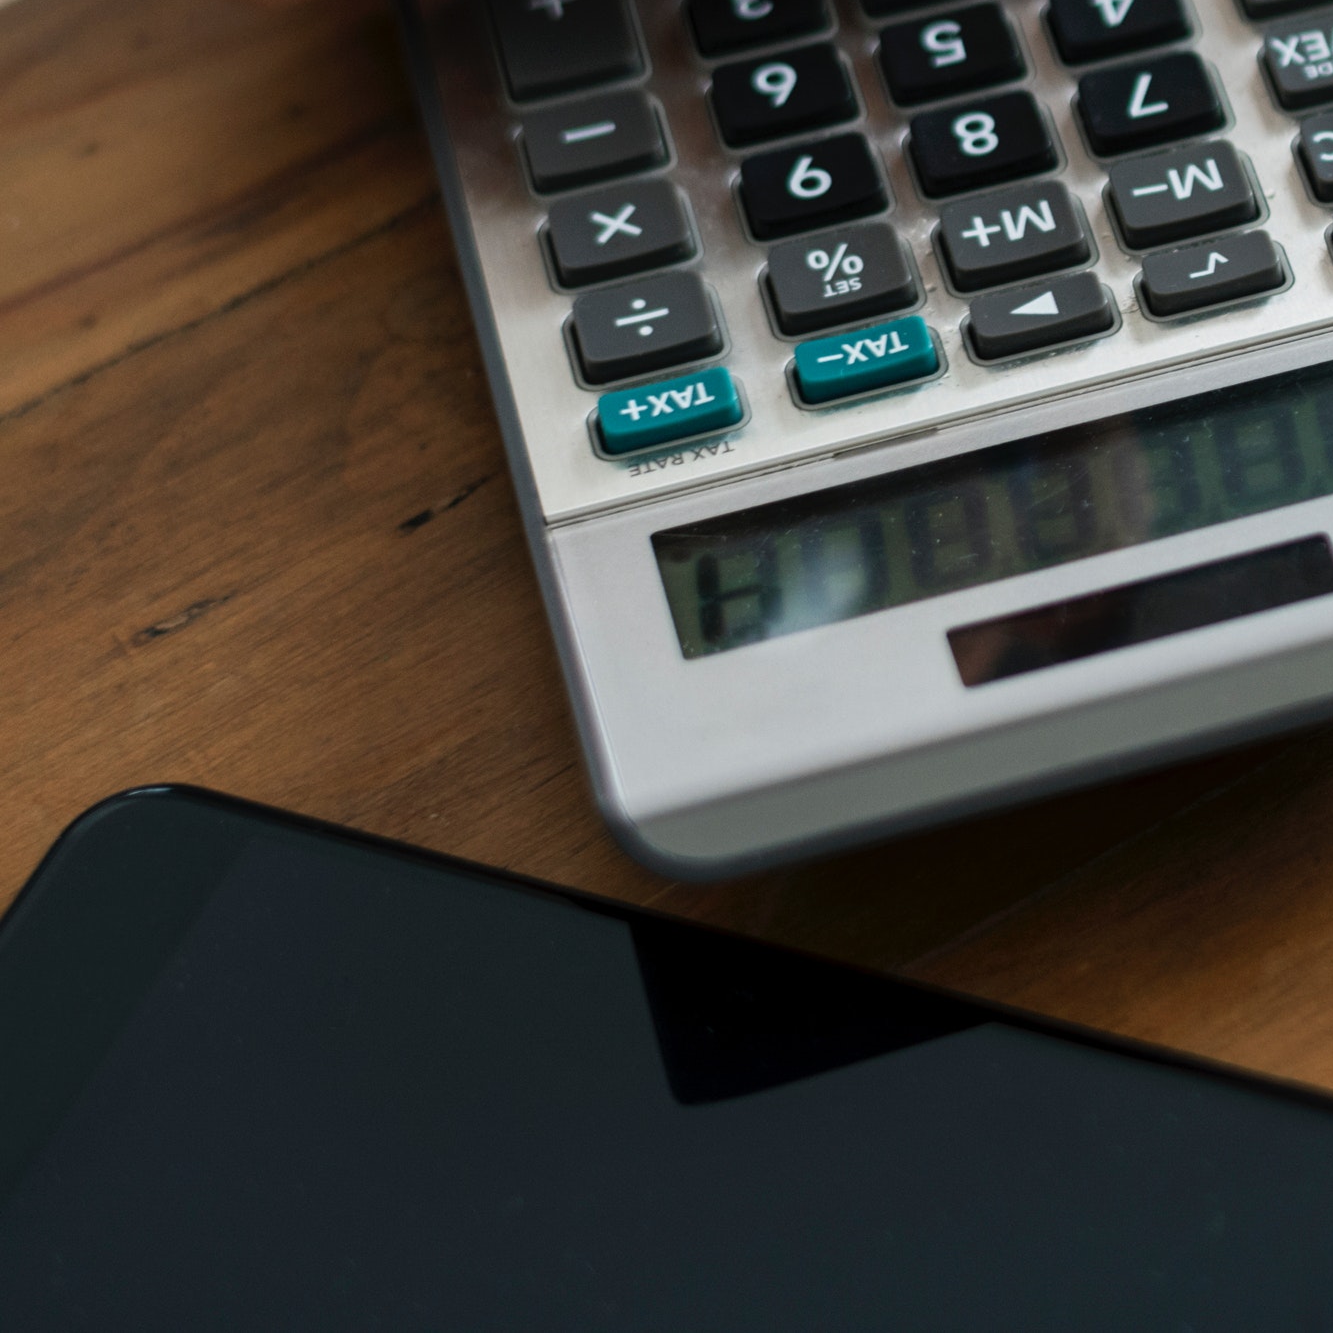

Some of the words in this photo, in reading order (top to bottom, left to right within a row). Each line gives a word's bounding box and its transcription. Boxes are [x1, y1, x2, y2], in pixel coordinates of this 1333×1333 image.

[920, 19, 968, 68] 5
[749, 61, 798, 108] 6
[1125, 73, 1171, 119] 7
[951, 110, 999, 157] 8
[789, 157, 831, 198] 9
[961, 197, 1057, 248] M+
[824, 277, 862, 297] SET
[620, 382, 715, 420] TAX+
[626, 453, 684, 477] RATE
[689, 441, 735, 461] TAX
